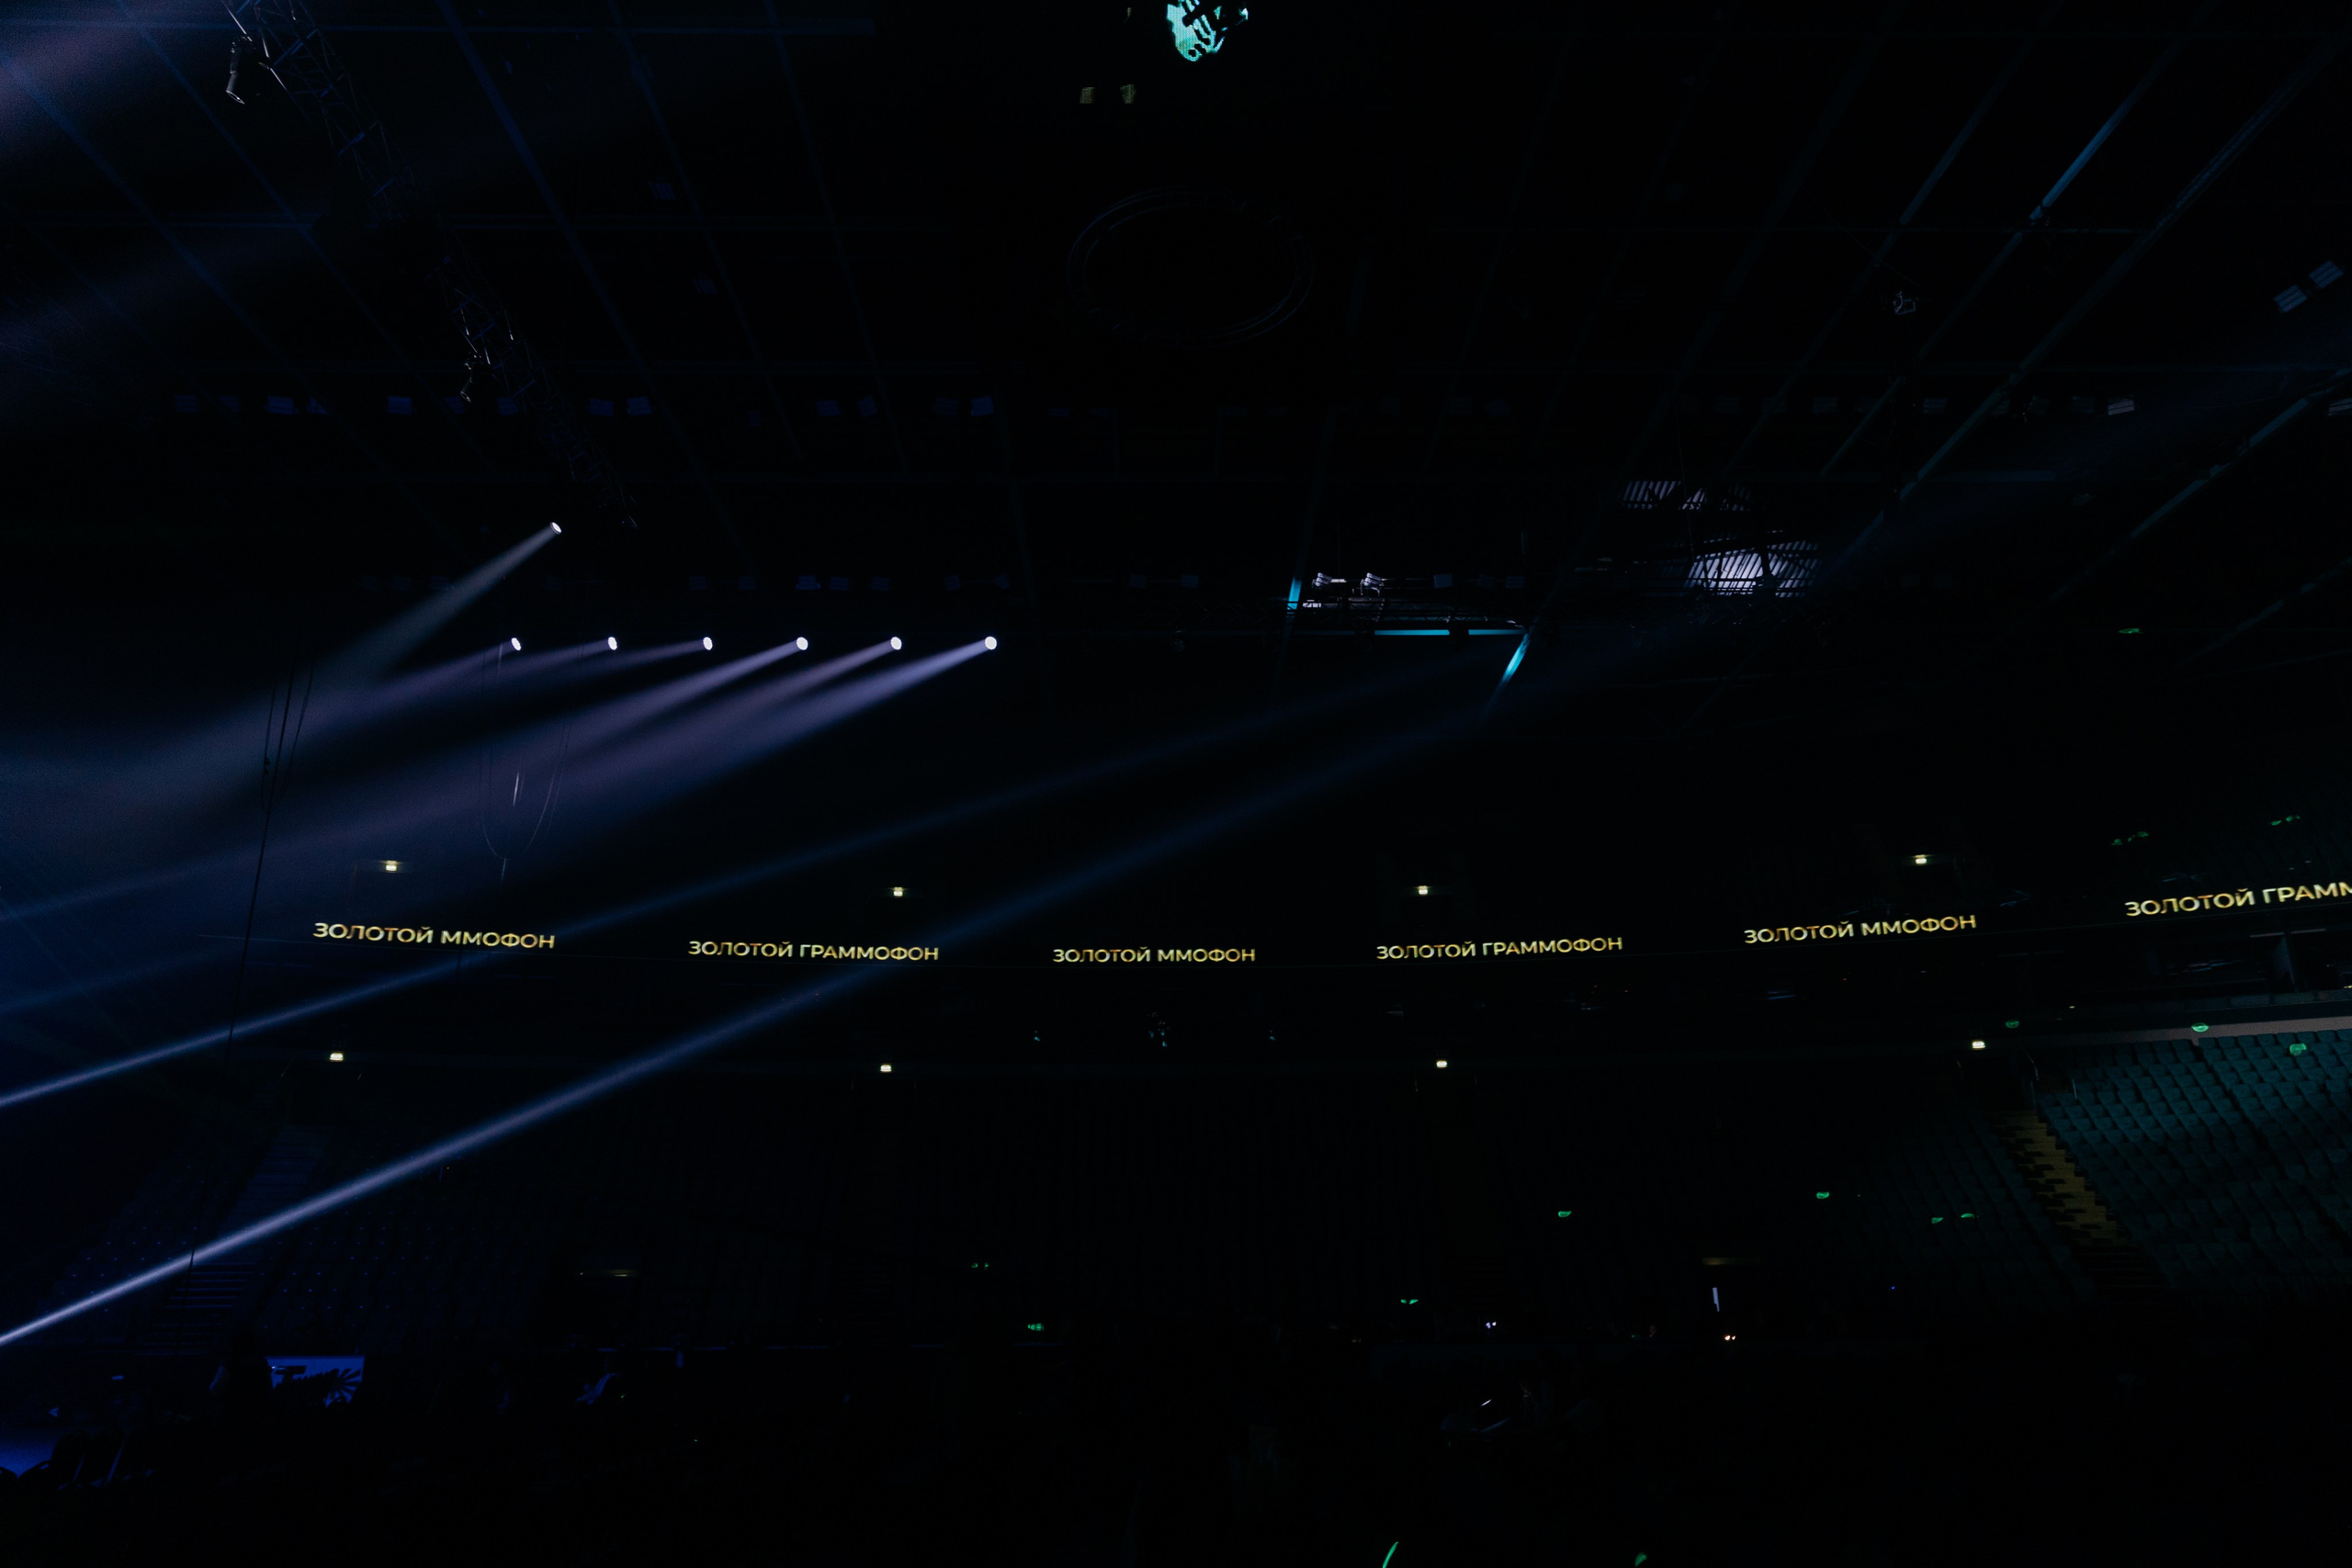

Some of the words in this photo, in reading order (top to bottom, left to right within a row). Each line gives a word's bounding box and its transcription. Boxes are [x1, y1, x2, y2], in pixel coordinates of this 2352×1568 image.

[2124, 887, 2256, 918] ЗОЛОТОЙ
[311, 921, 435, 944] ЗОЛОТОЙ
[440, 930, 556, 950] ММОФОН
[1743, 919, 1855, 944] ЗОЛОТОЙ
[1860, 914, 1977, 937] ММОФОН
[687, 940, 794, 958] ЗОЛОТОЙ
[799, 943, 940, 962] ГРАММОФОН
[1052, 945, 1151, 964] ЗОЛОТОЙ
[1157, 948, 1256, 963] ММОФОН
[1376, 940, 1476, 960] ЗОЛОТОЙ
[1481, 936, 1623, 956] ГРАММОФОН
